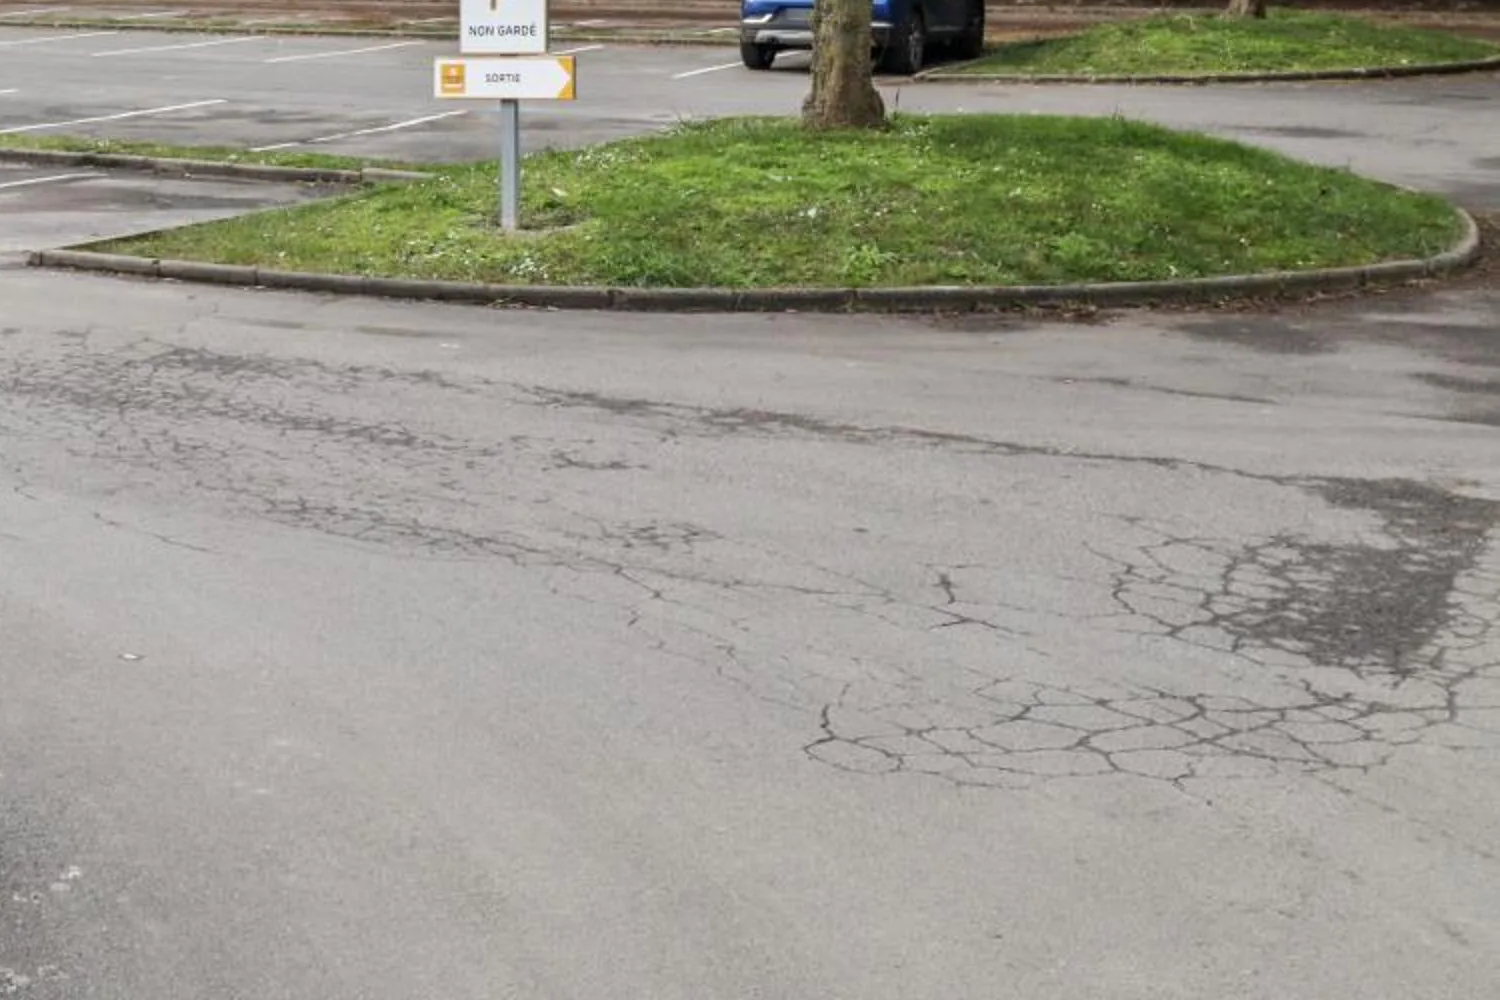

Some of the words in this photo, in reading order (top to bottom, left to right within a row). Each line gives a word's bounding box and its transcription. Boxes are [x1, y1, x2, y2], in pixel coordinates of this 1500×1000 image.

[468, 25, 495, 37] NON
[497, 21, 538, 37] GARDÉ
[485, 73, 521, 83] SORTIE
